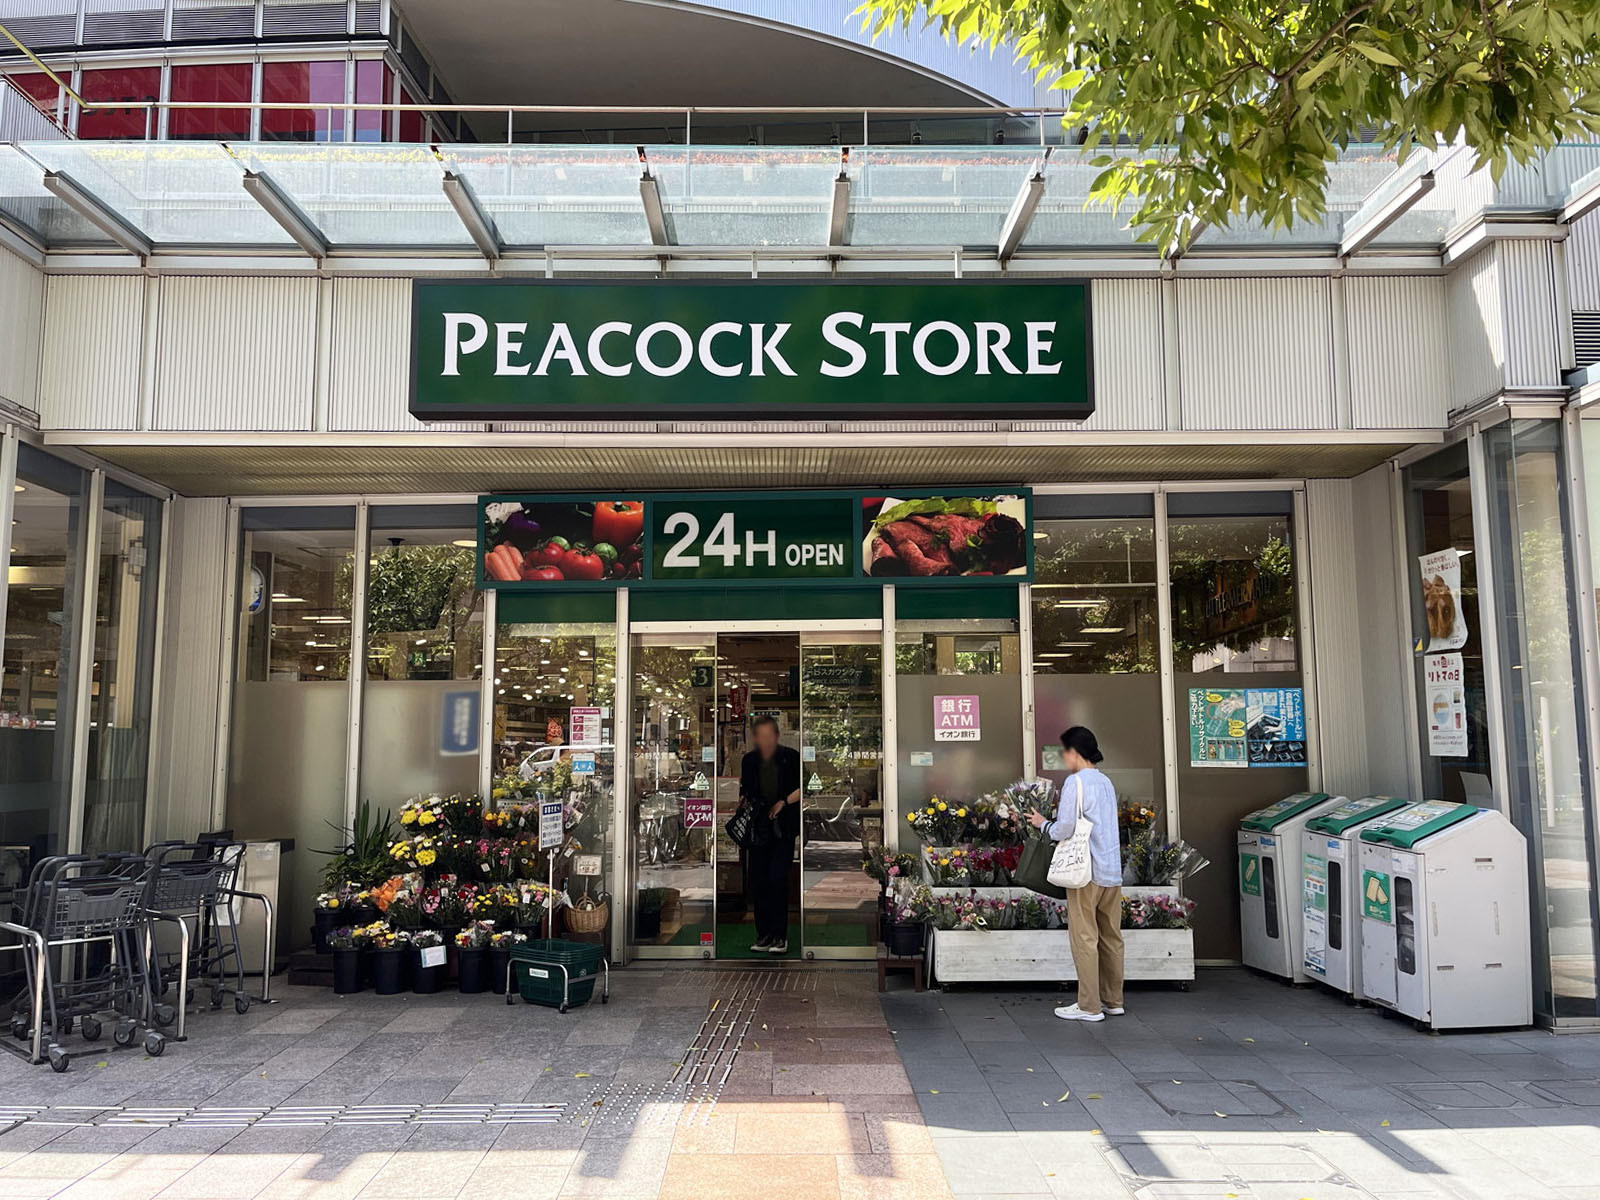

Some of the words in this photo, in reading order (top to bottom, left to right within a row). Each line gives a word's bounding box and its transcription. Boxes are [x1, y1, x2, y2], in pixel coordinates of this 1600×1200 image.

[441, 312, 798, 377] PEACOCK
[819, 311, 1063, 378] STORE
[662, 511, 776, 567] 24H
[785, 544, 844, 566] OPEN
[940, 699, 972, 713] 銀行
[941, 714, 974, 727] ATM
[939, 730, 976, 738] イオン銀行
[686, 812, 712, 822] ATM
